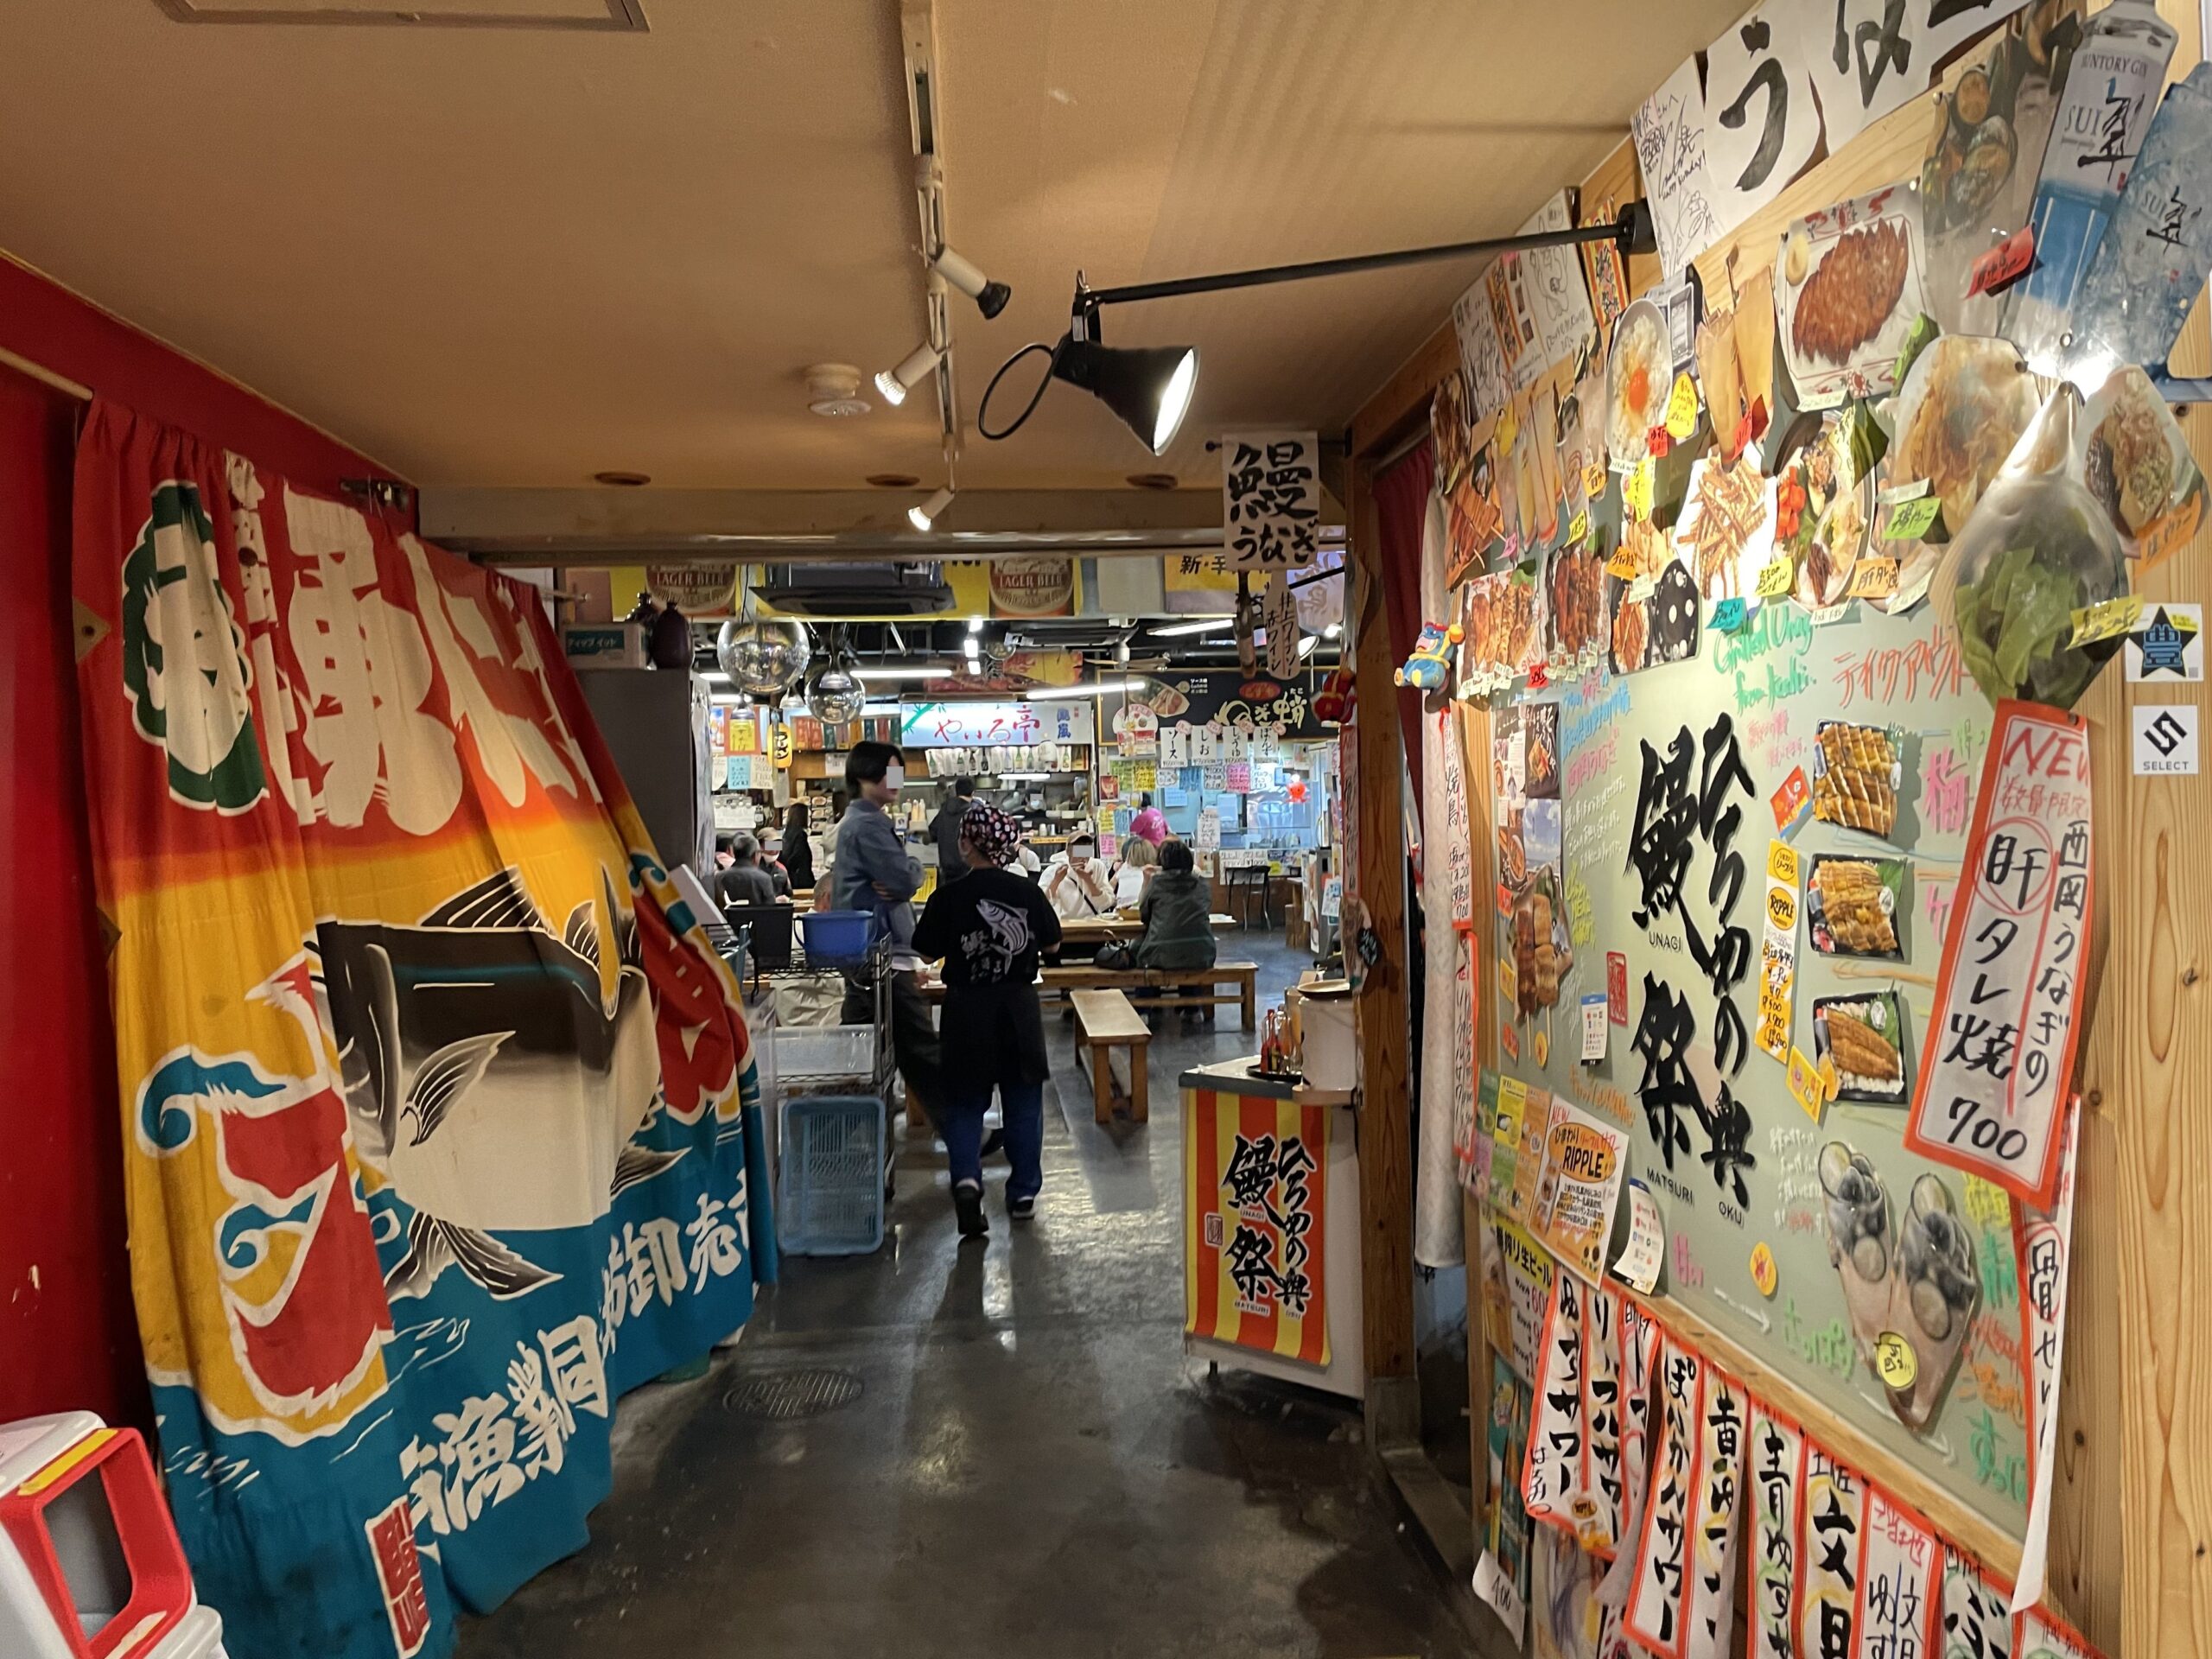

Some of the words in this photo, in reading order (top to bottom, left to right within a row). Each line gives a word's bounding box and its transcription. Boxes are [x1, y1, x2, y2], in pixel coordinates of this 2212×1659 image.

[2064, 104, 2104, 137] SUI
[1228, 442, 1319, 523] 鰻
[1232, 518, 1320, 564] うなぎ
[657, 572, 693, 587] LAGER
[696, 572, 724, 587] BEER
[998, 574, 1033, 588] LAGER
[1036, 573, 1064, 588] BEER
[934, 704, 1040, 744] やいろ亭
[1168, 729, 1179, 760] ソース
[1199, 728, 1211, 756] しお
[2143, 760, 2190, 772] SELECT
[1648, 930, 1683, 954] UNAGI
[1942, 833, 2049, 1081] 肝タレ焼
[2024, 819, 2090, 1097] 西岡うなぎの
[1554, 1126, 1580, 1145] ひまわり
[1947, 1096, 2029, 1161] 700
[1562, 1145, 1605, 1179] RIPPLE
[1646, 1166, 1694, 1208] MATSURI
[1719, 1201, 1744, 1227] OKU
